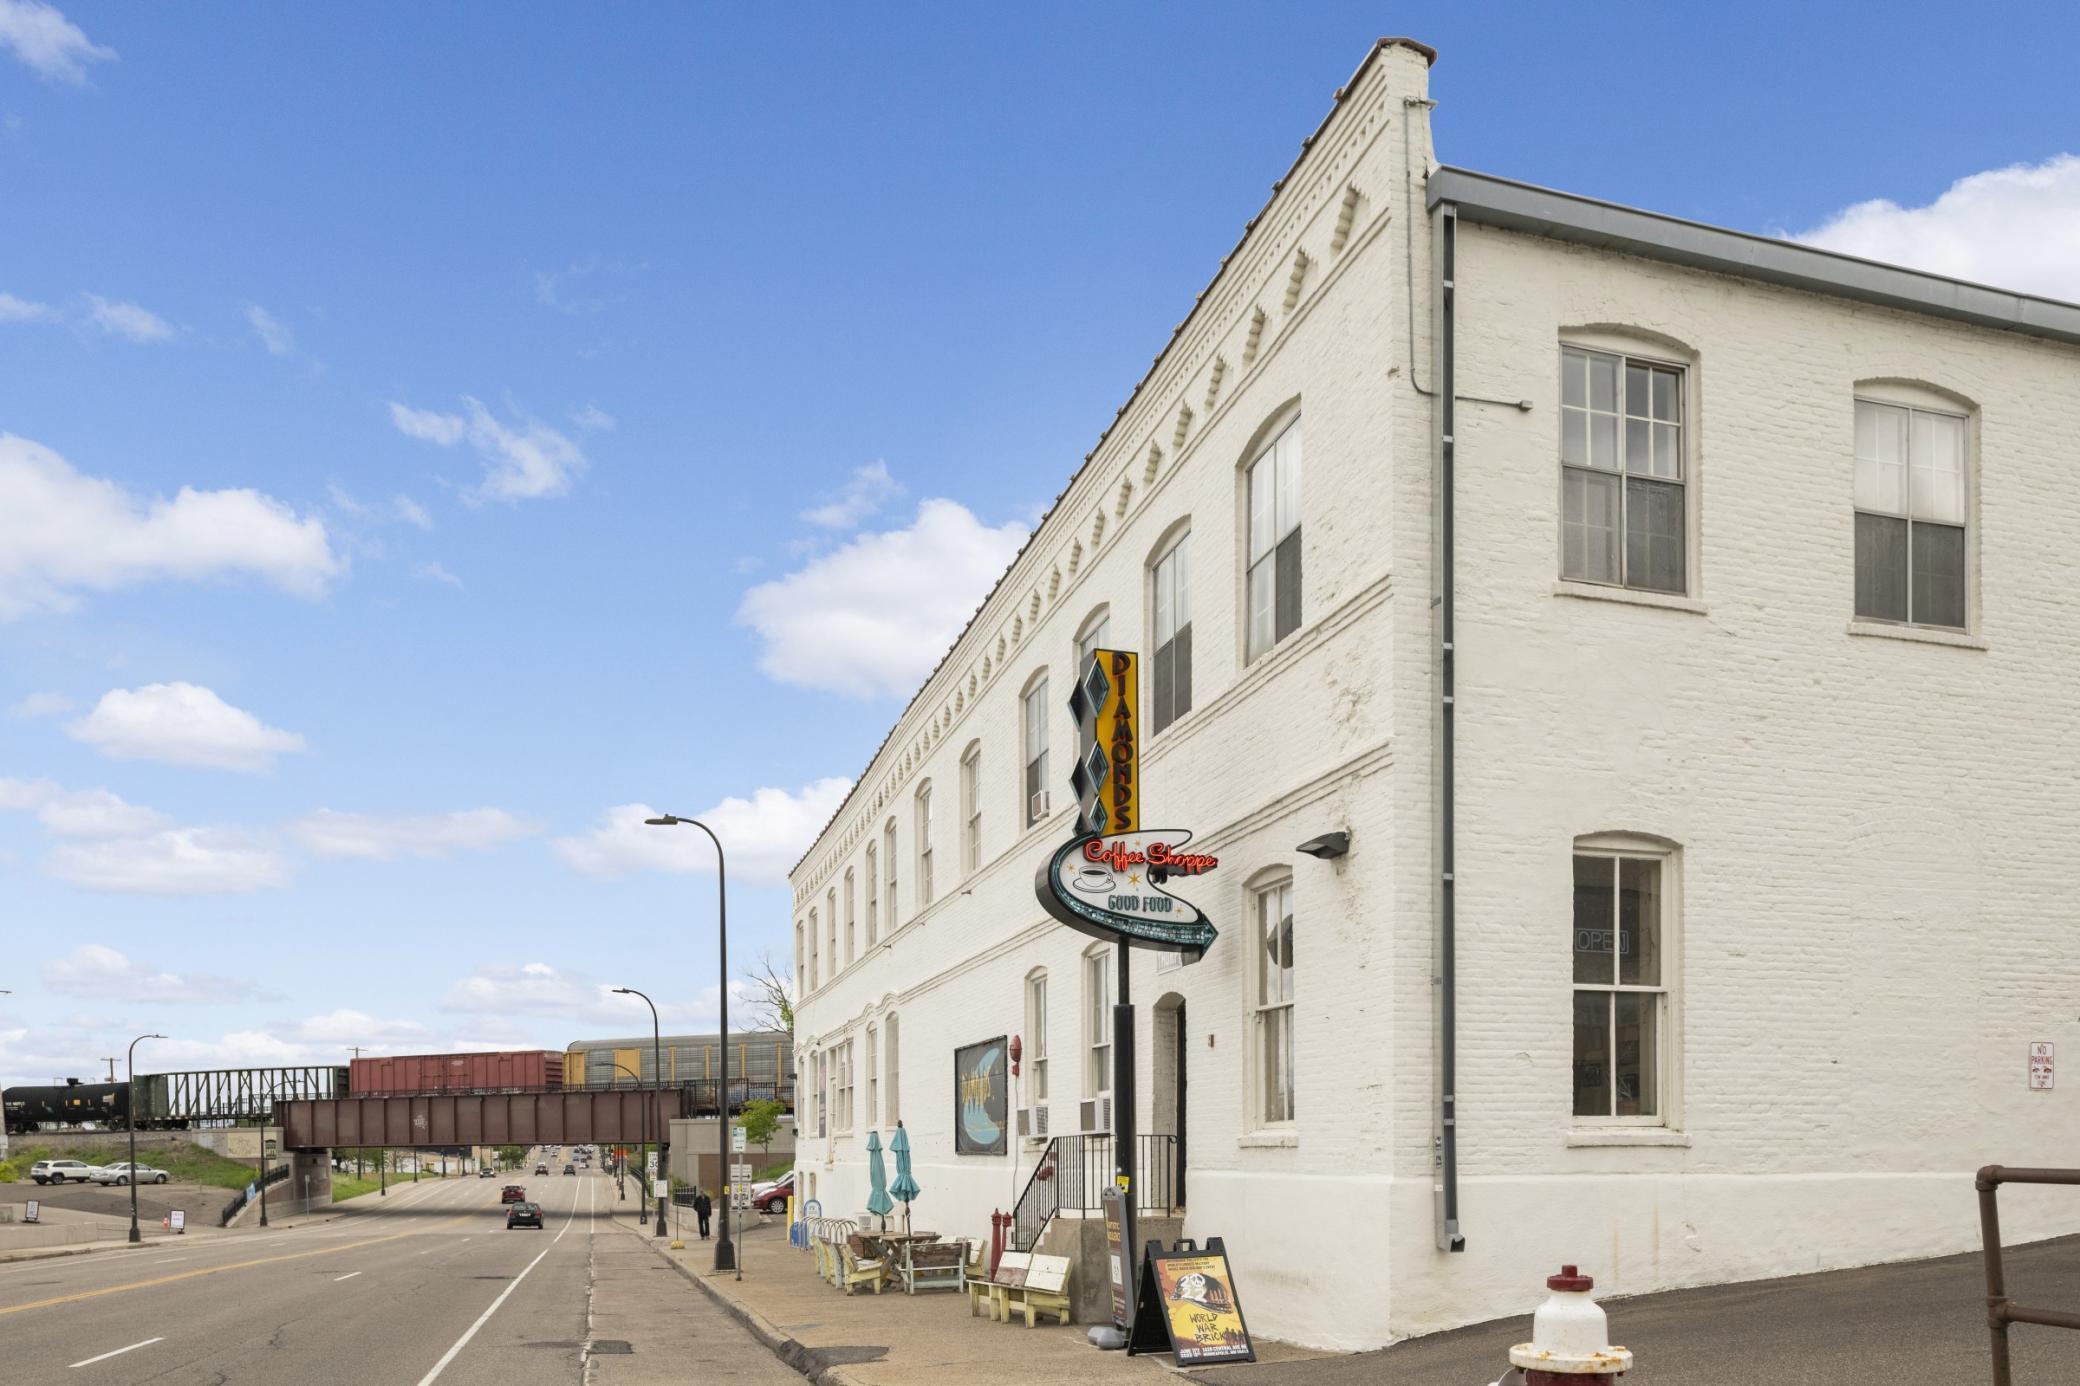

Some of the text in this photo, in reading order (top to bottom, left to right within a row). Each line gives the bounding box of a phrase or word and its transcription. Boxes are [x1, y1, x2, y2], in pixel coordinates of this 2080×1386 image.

[1111, 652, 1134, 830] DIAMONDS
[1084, 839, 1218, 875] Coffee Shoppe
[1108, 895, 1173, 912] GOOD FOOD
[2037, 1046, 2047, 1055] NO
[1189, 1313, 1218, 1323] WORLD
[1196, 1323, 1218, 1333] WAR
[1194, 1331, 1225, 1342] BRICK
